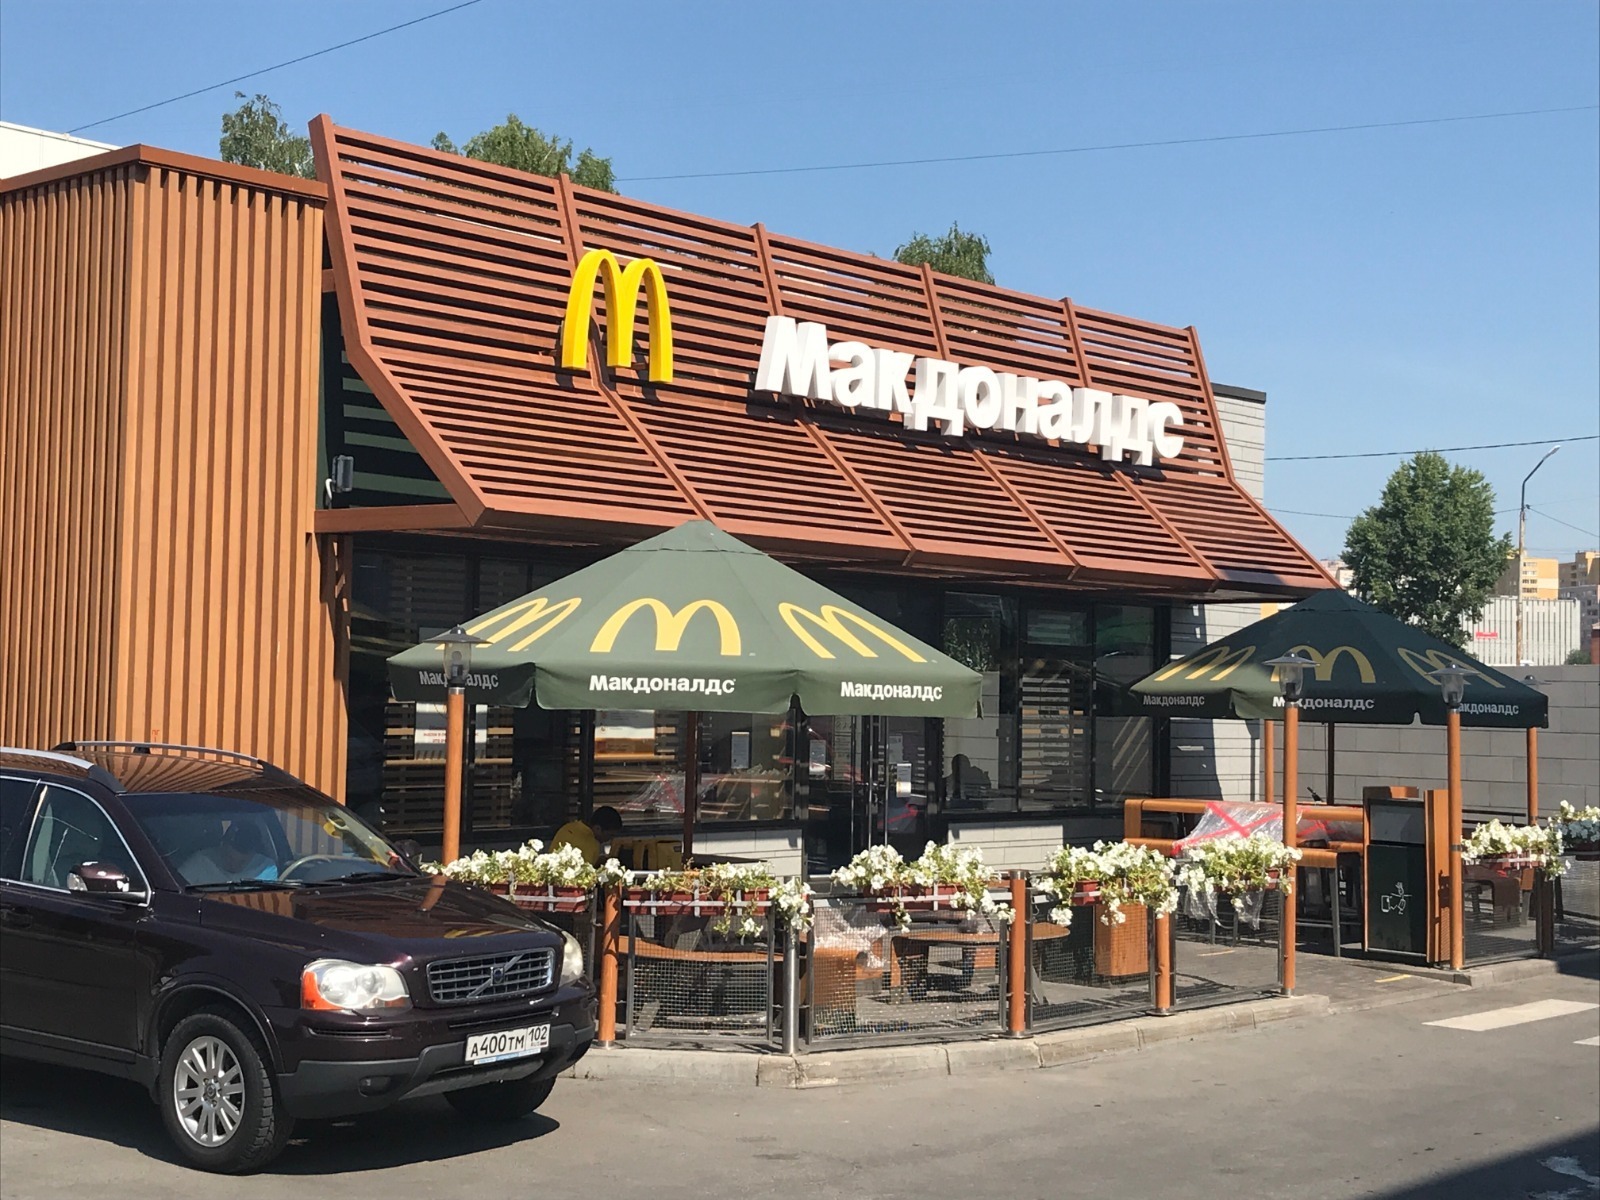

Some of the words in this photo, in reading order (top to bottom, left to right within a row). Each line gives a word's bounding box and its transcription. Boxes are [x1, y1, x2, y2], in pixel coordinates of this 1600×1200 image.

[754, 315, 1185, 467] Макдоналдс
[419, 670, 499, 690] Макалдс
[589, 674, 736, 696] Макдоналдс
[840, 681, 943, 702] Макдоналдс
[1143, 694, 1205, 708] Макдоналдс
[1458, 702, 1520, 716] акдоналдс
[528, 1026, 548, 1042] 102
